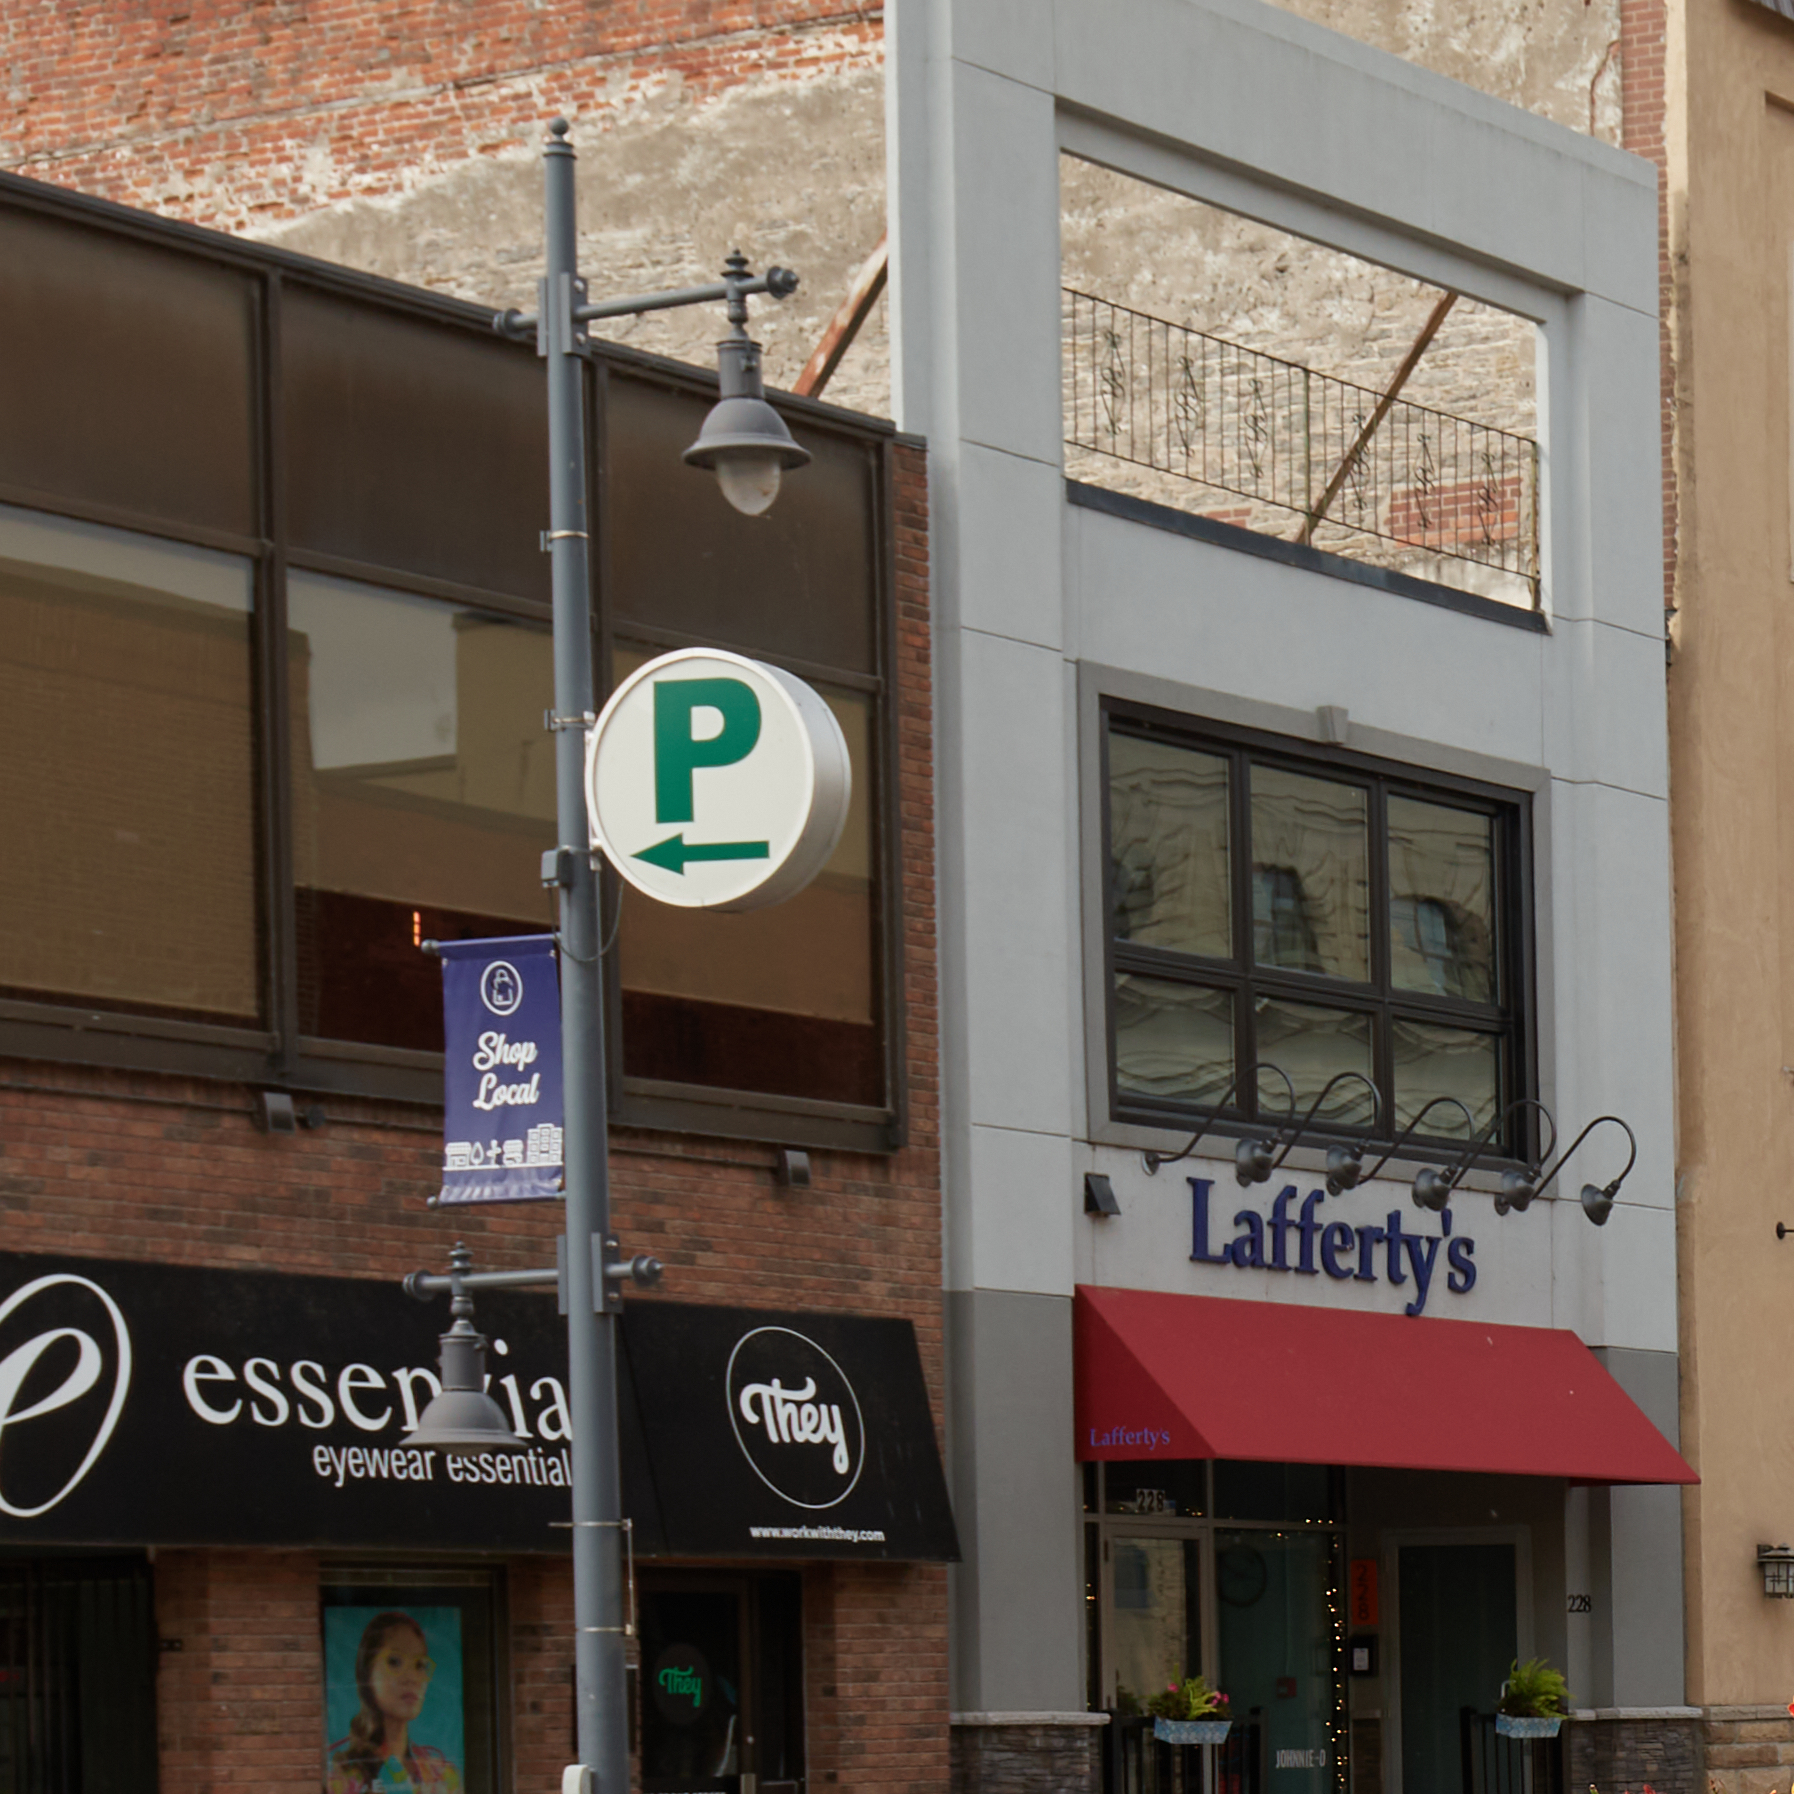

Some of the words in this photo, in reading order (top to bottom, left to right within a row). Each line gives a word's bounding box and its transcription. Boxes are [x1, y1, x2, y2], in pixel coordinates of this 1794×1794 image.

[654, 677, 762, 823] P
[473, 1031, 538, 1071] Shop
[472, 1072, 541, 1110] Local
[1186, 1176, 1477, 1317] Lafferty's
[740, 1376, 849, 1475] They
[1090, 1426, 1170, 1450] Lafferty's
[313, 1443, 434, 1486] eyewear
[1136, 1489, 1165, 1513] 228
[749, 1525, 886, 1543] www.workwiththey.com
[1567, 1594, 1593, 1614] 228
[658, 1665, 702, 1708] They
